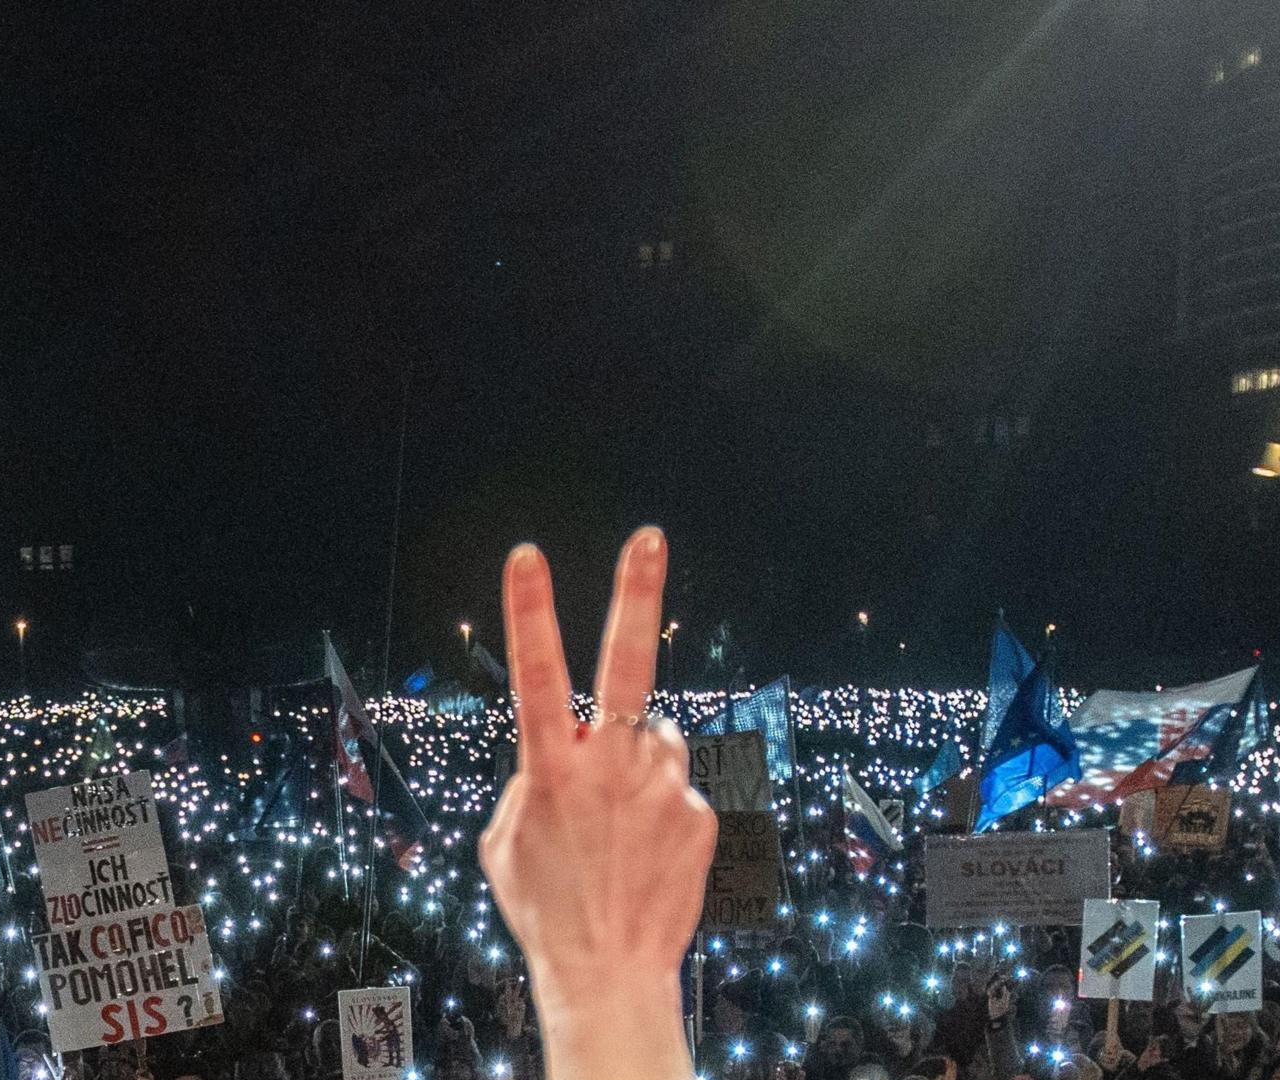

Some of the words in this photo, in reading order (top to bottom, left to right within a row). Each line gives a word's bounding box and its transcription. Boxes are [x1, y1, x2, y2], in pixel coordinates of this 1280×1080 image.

[89, 854, 129, 885] ICH
[960, 856, 1065, 878] SLOVÁCI
[33, 927, 89, 970] TAK
[48, 948, 199, 1011] POMOHEL
[101, 996, 168, 1044] SIS
